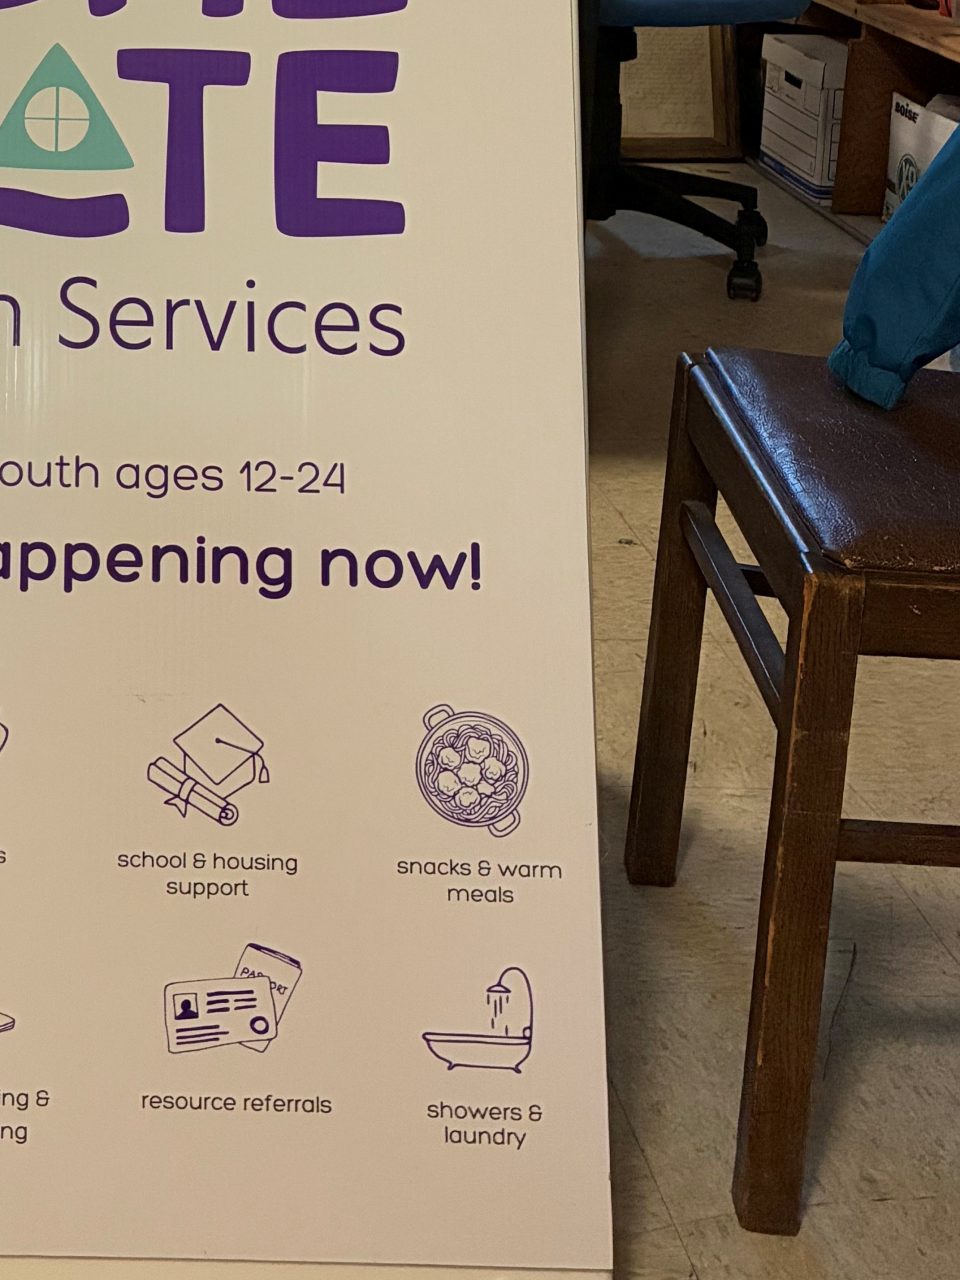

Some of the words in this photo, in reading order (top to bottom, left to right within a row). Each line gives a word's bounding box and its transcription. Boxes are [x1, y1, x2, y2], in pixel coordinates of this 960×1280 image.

[58, 276, 406, 357] Services
[116, 463, 224, 499] ages
[239, 460, 345, 494] 12-24
[320, 541, 481, 591] now!
[117, 850, 187, 869] school
[192, 852, 207, 869] &
[213, 852, 298, 876] housing
[397, 858, 472, 876] snacks
[477, 859, 492, 877] &
[497, 863, 562, 879] warm
[166, 879, 250, 900] support
[447, 886, 514, 904] meals
[35, 1089, 50, 1107] &
[142, 1094, 237, 1111] resource
[243, 1094, 332, 1114] referrals
[427, 1101, 523, 1121] showers
[528, 1104, 543, 1122] &
[444, 1125, 527, 1151] laundry
